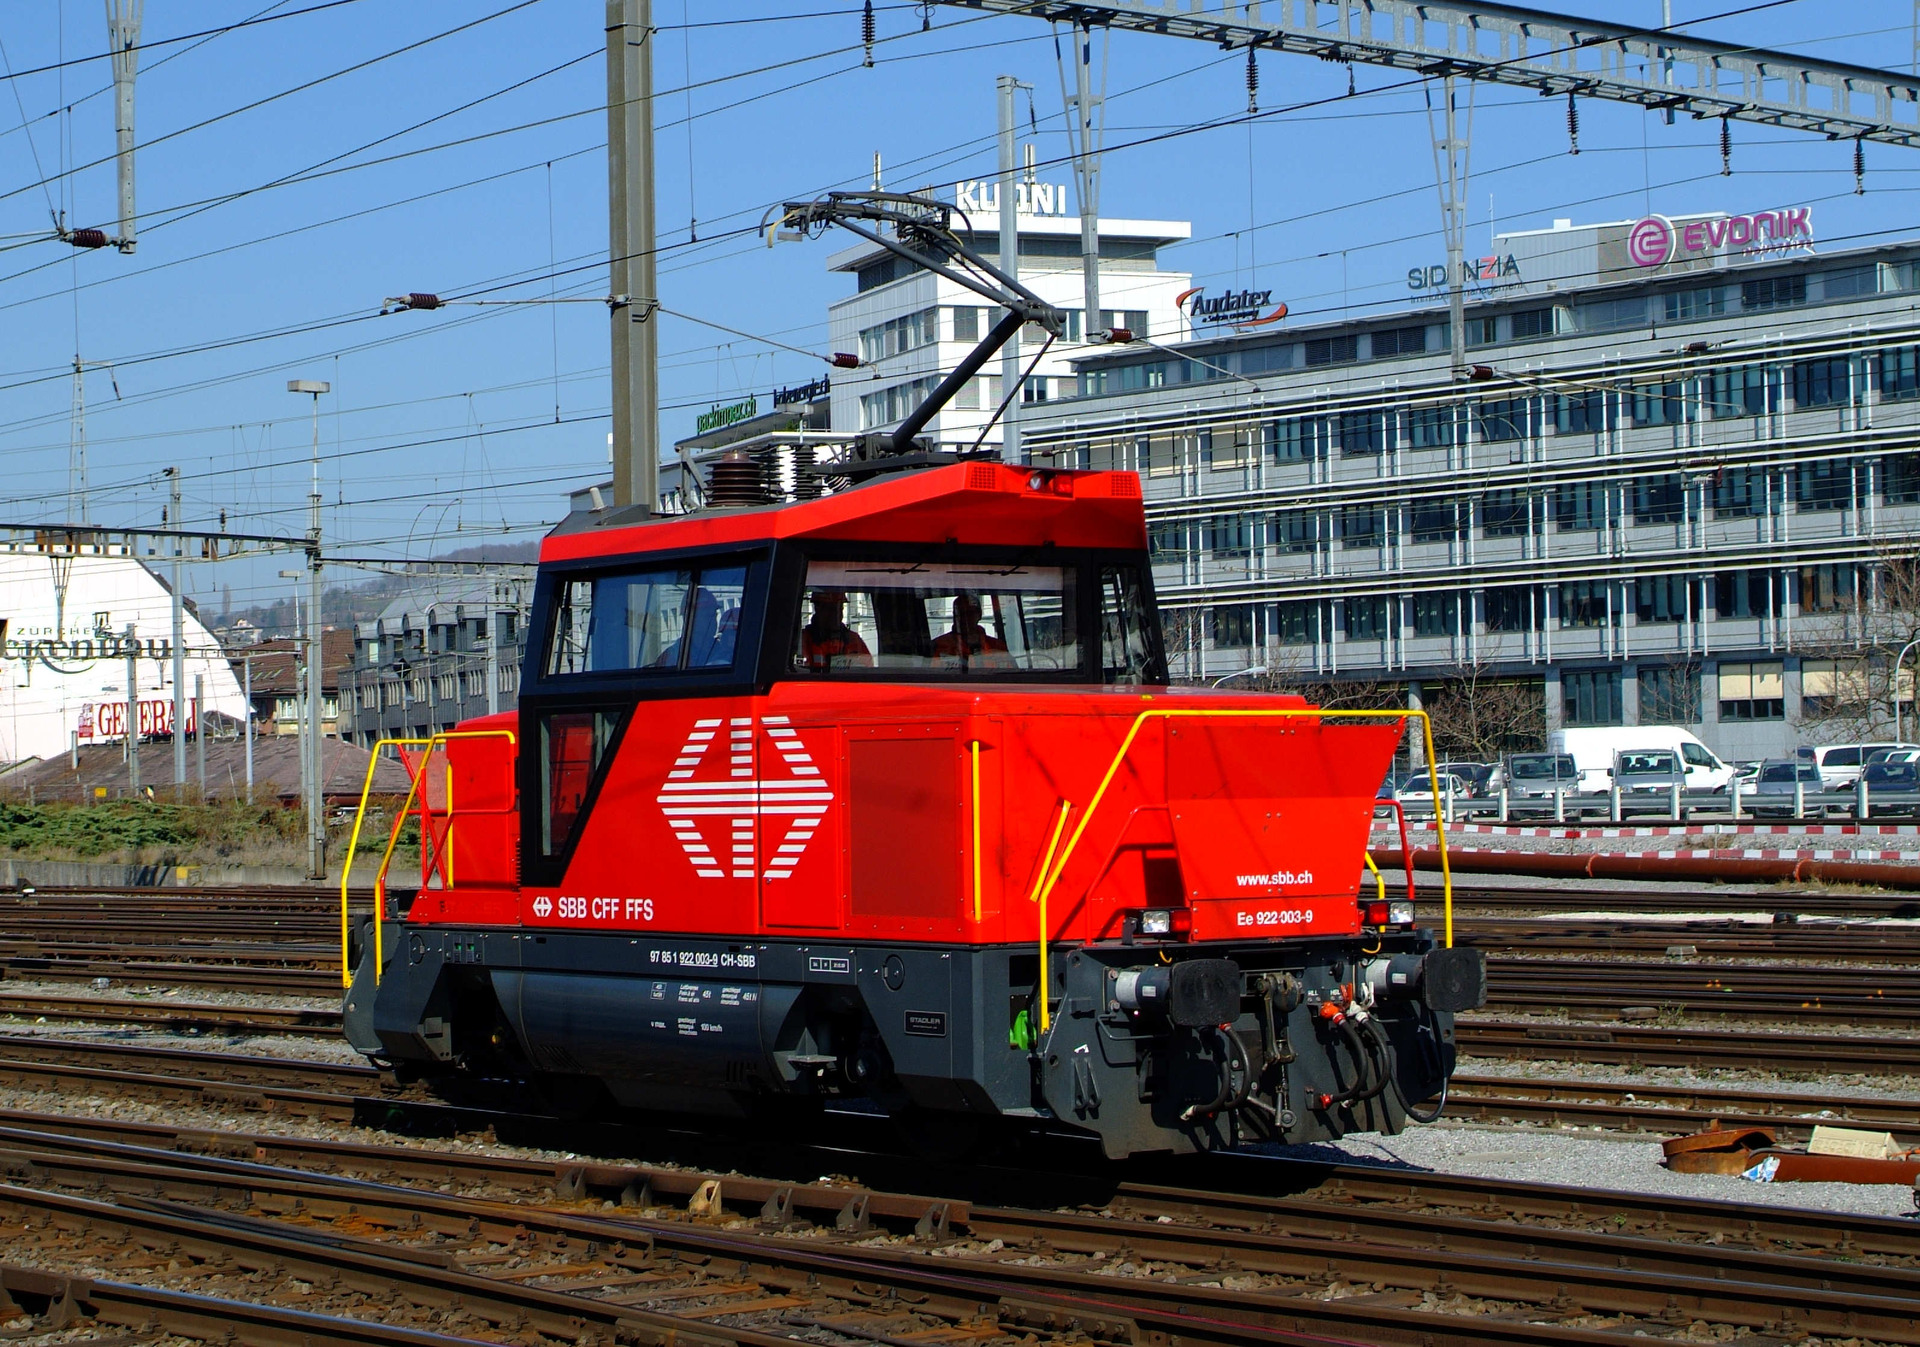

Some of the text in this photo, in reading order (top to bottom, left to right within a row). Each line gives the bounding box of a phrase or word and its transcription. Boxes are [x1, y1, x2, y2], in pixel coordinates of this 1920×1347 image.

[1683, 207, 1811, 251] EVONIK
[1408, 253, 1520, 290] SIDNZIA
[1190, 289, 1272, 316] Audatex
[696, 392, 757, 436] packimpex.ch
[17, 626, 93, 636] ZÜRHE
[98, 697, 199, 736] GEERAI
[1236, 869, 1313, 886] www.sbb.ch
[558, 897, 654, 921] SBB CFF FFS
[1237, 909, 1313, 926] Ee 922 003-9
[650, 950, 756, 968] 97 85 1 922 003-9 CH-SBB
[909, 1016, 941, 1025] STADLER
